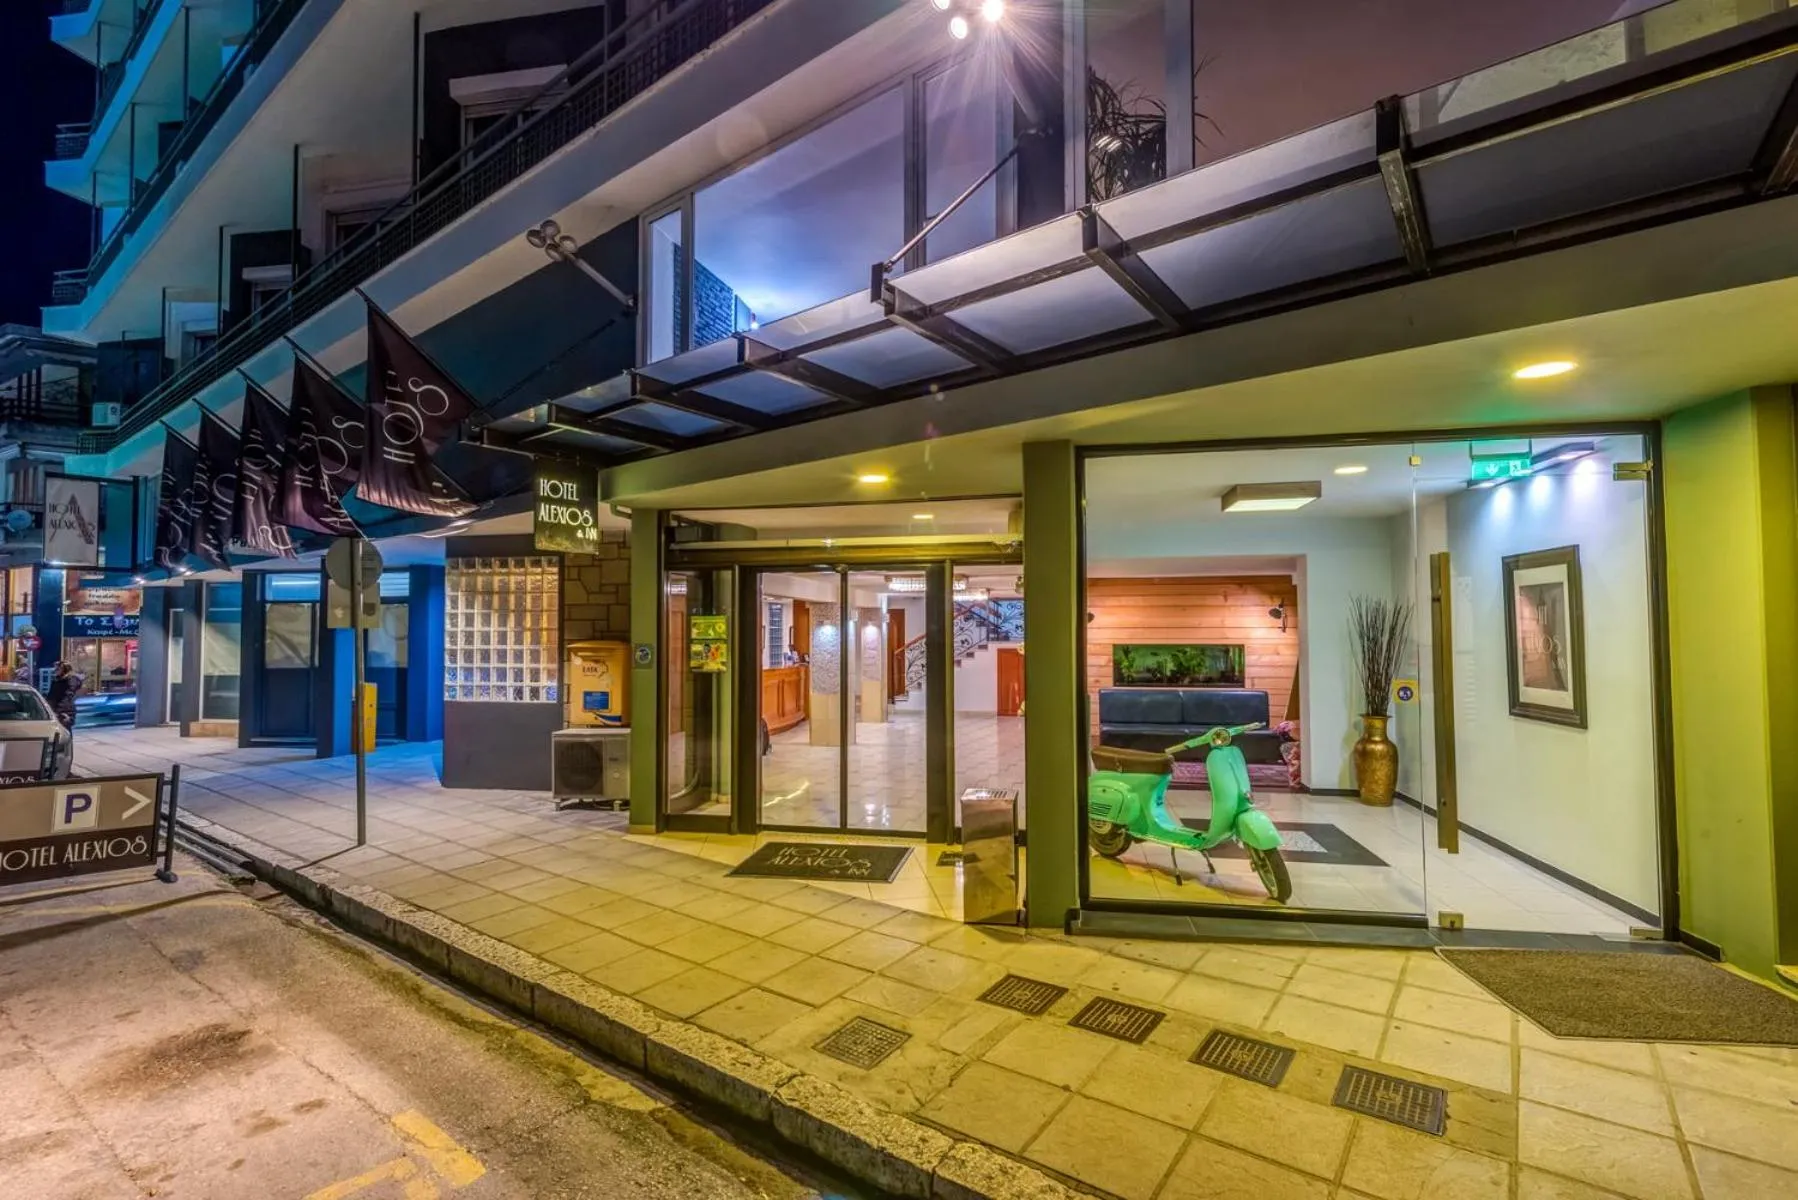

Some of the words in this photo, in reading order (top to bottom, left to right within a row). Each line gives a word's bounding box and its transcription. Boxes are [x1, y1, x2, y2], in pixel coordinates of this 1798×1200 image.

[540, 478, 579, 501] HOTEL
[538, 503, 593, 527] ALEXIOS
[64, 793, 93, 825] P
[0, 845, 58, 872] OTEL
[62, 835, 148, 865] ALEXIOS
[778, 847, 849, 858] HOTEL
